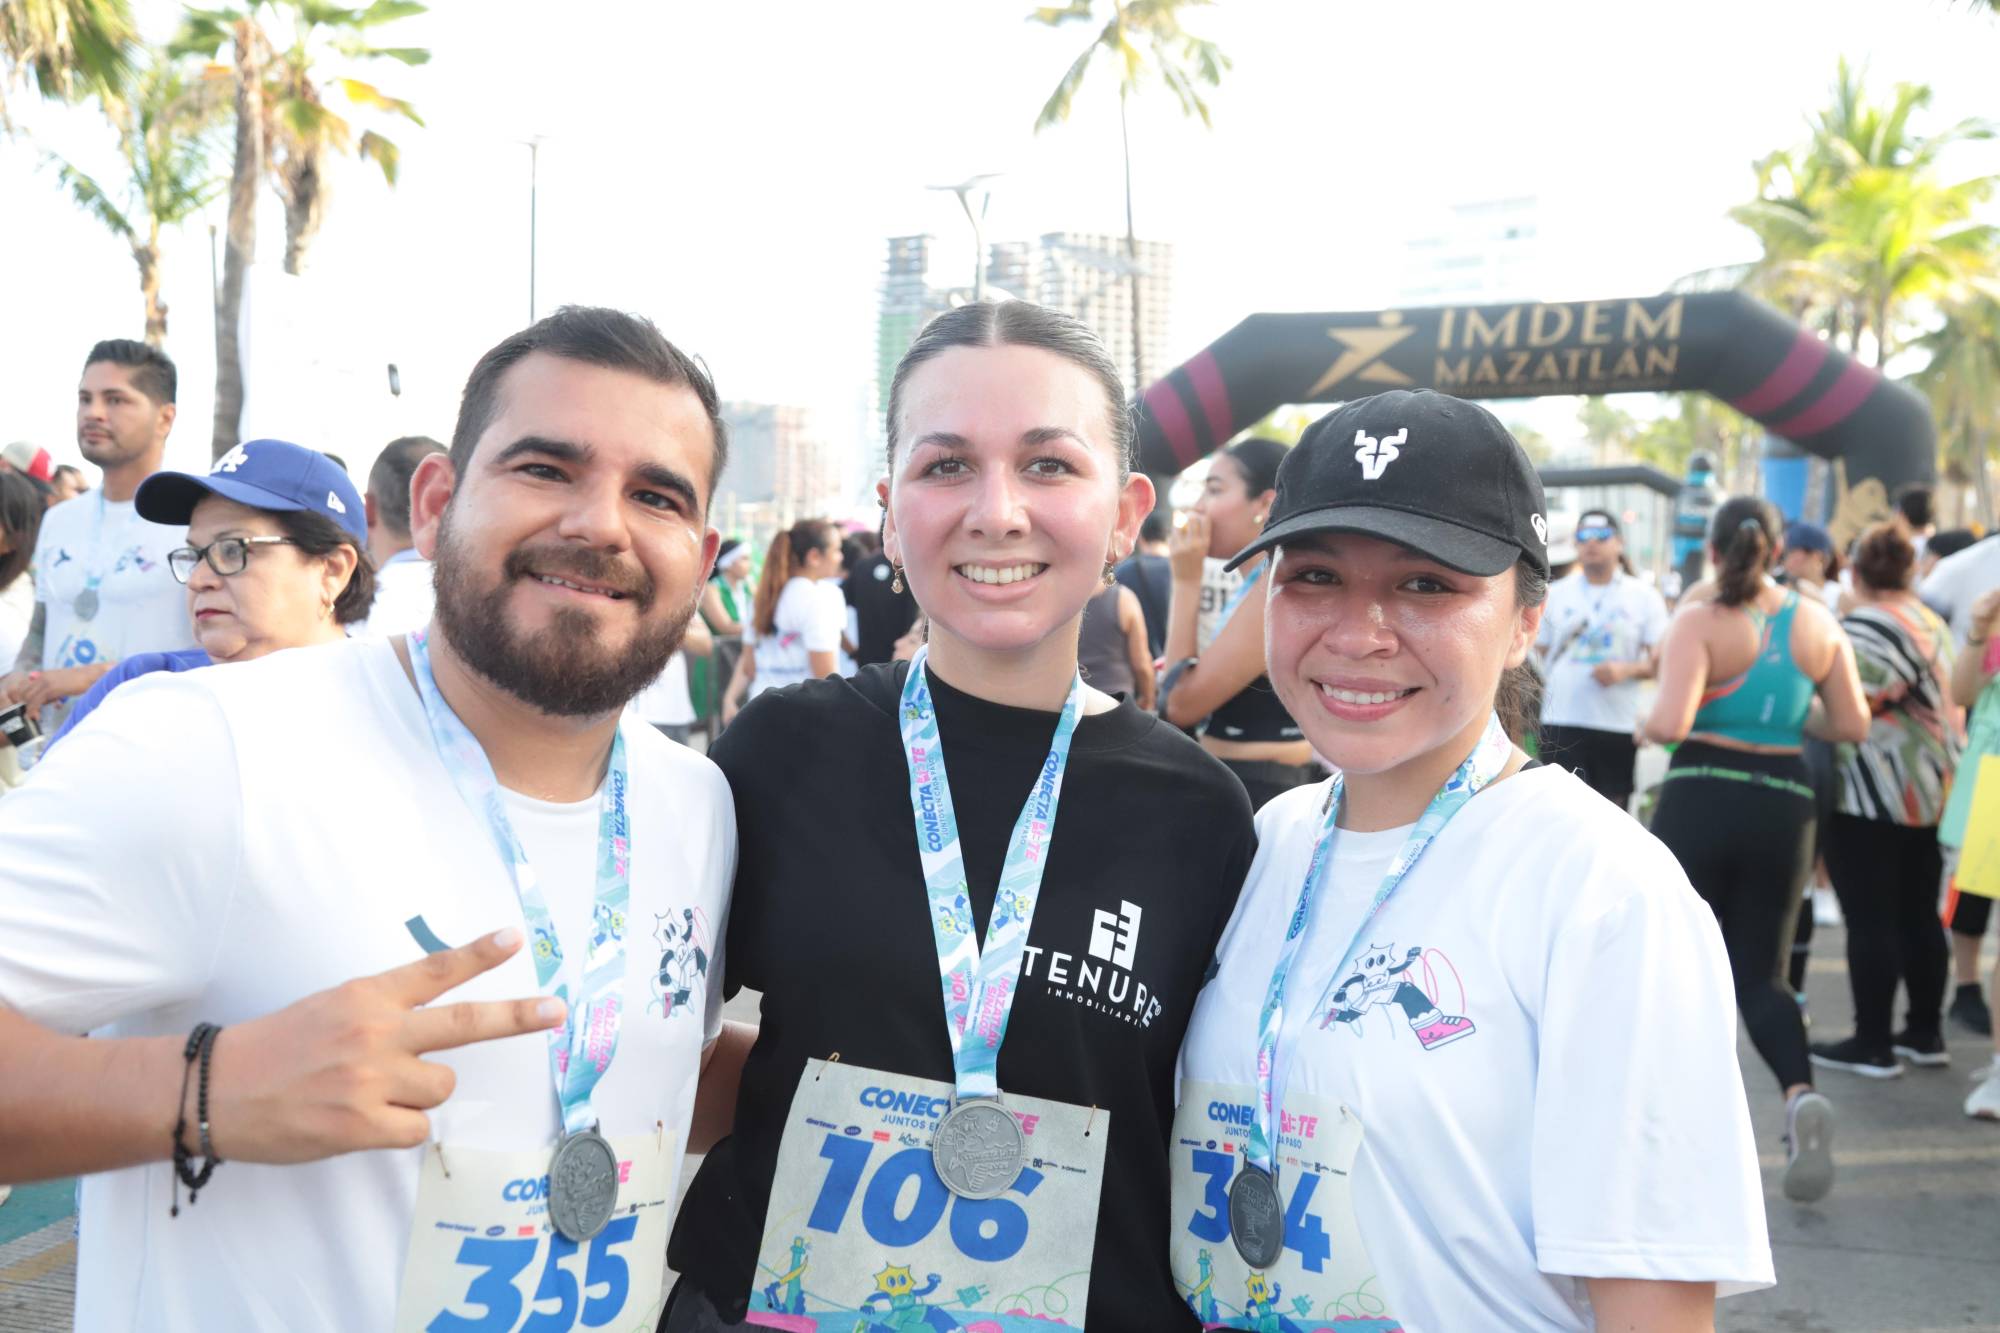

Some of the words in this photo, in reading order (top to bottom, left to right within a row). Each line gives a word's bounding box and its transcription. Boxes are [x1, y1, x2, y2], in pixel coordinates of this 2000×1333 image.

[1437, 298, 1685, 349] IMDEM
[614, 769, 626, 837] CONECTA
[919, 783, 942, 852] CONECTA
[1035, 750, 1060, 819] CONECTA
[951, 970, 966, 1002] 10K
[978, 985, 998, 1037] SINALOA
[1024, 945, 1158, 1028] TENURE
[1047, 987, 1142, 1028] INMOBILIARI
[881, 1114, 926, 1130] JUNTOS
[807, 1133, 1045, 1263] 106
[1187, 1149, 1331, 1273] 34
[425, 1214, 639, 1333] 355
